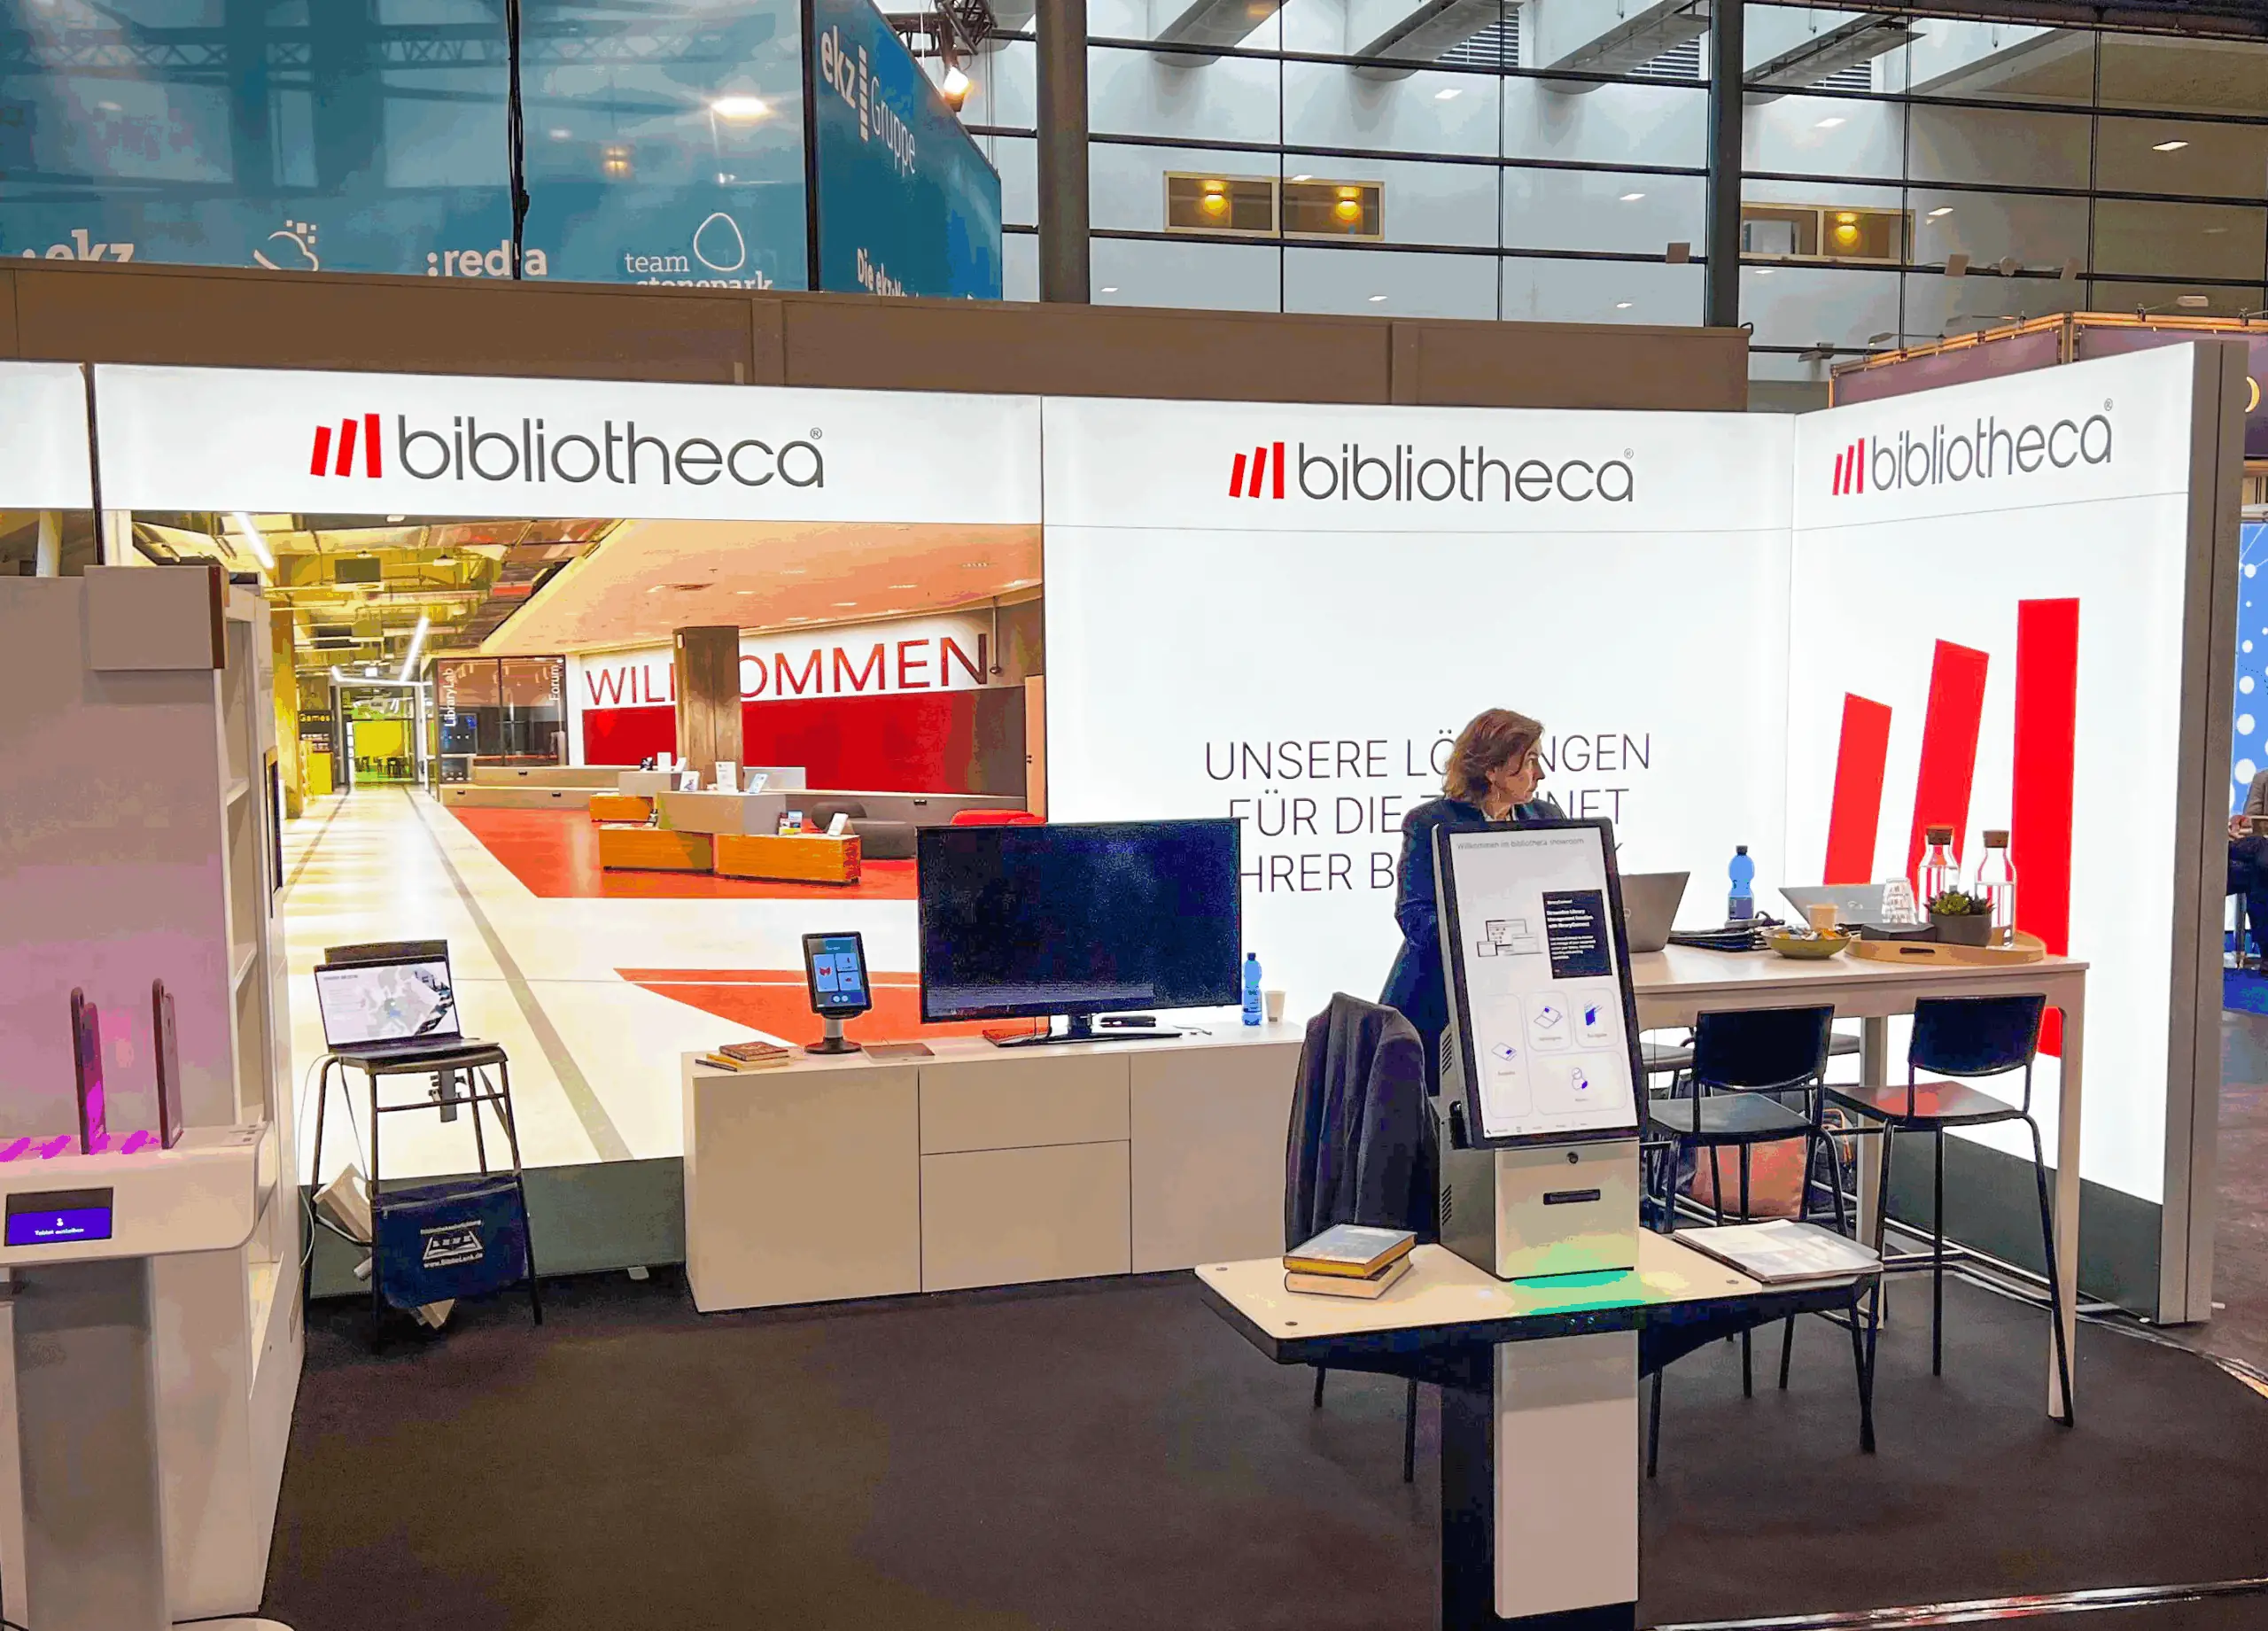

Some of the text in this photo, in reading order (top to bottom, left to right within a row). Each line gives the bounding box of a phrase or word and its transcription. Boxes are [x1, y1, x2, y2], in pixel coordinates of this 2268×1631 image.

[821, 25, 916, 177] ekz Gruppe
[427, 239, 548, 276] :reda
[625, 253, 690, 273] team
[857, 247, 874, 291] Die
[549, 664, 560, 701] Forum
[1206, 729, 1650, 781] UNSERE LÖNGEN
[1230, 788, 1317, 836] FÜR
[1336, 795, 1403, 835] DIE
[1240, 853, 1352, 893] HRER
